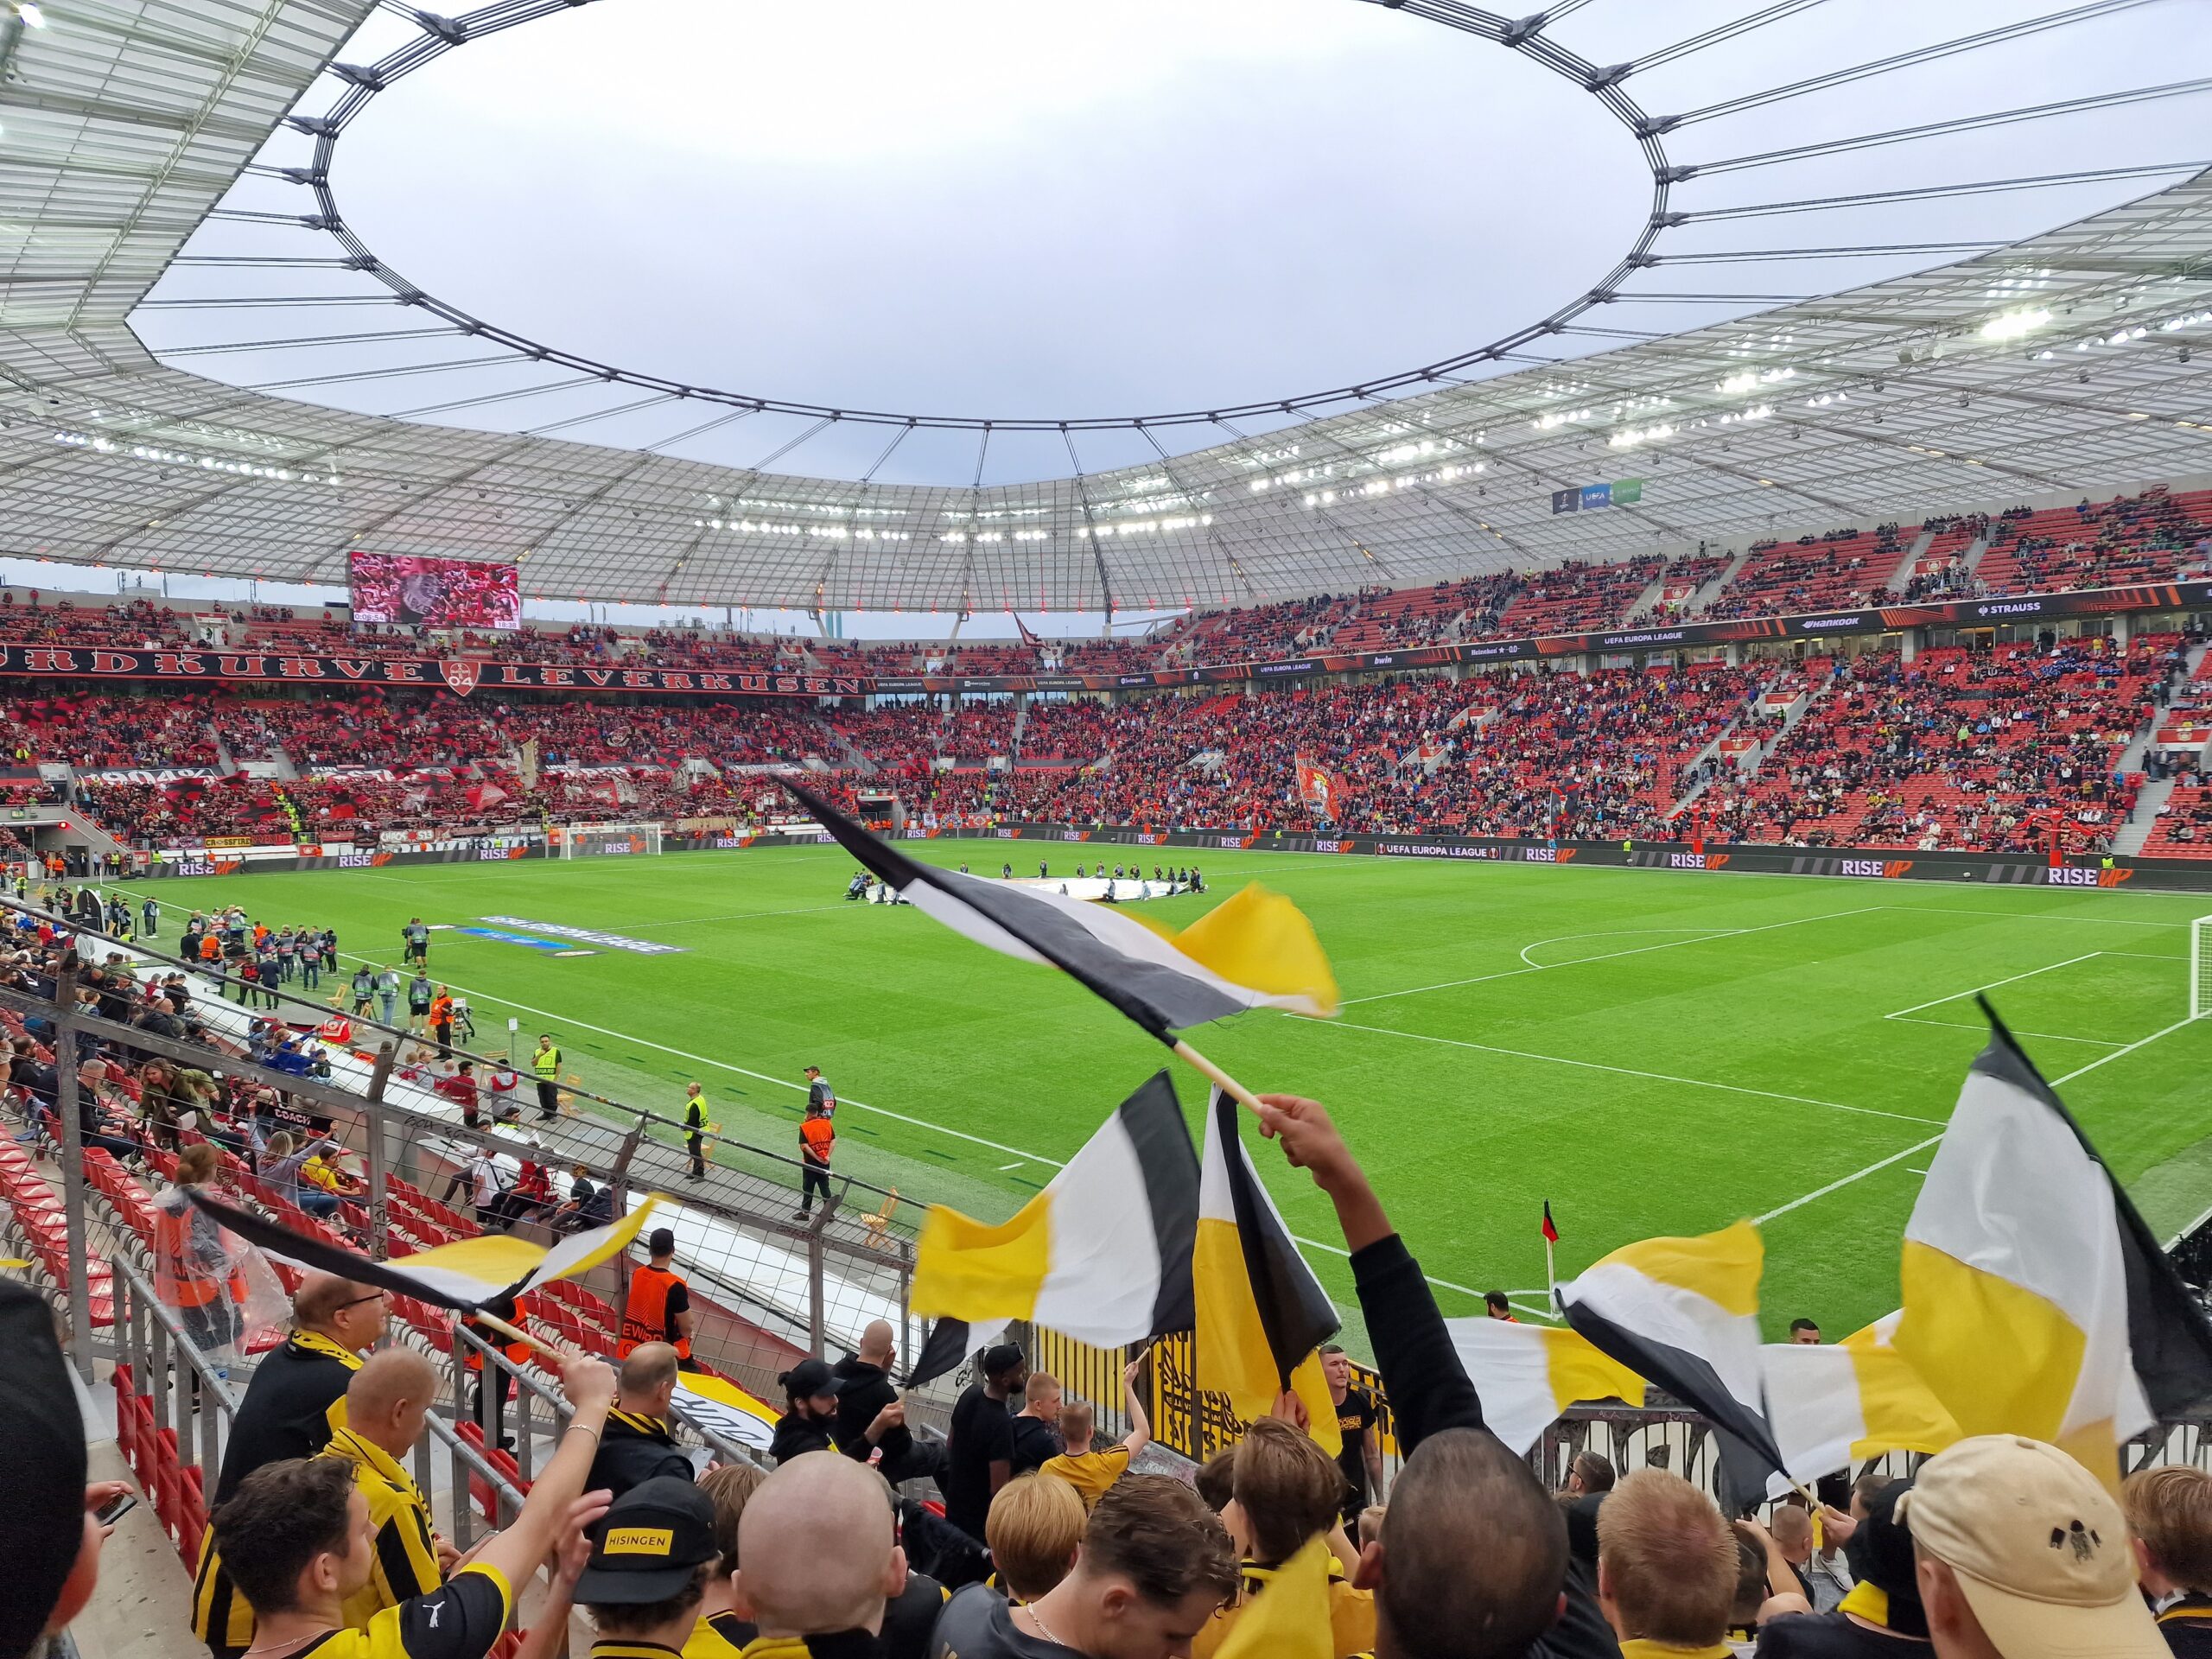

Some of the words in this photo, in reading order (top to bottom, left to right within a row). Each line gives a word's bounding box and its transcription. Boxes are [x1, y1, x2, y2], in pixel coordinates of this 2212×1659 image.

[1586, 492, 1605, 500] UEFA
[1990, 601, 2041, 614] STRAUSS
[1624, 634, 1653, 643] EUROPA
[1654, 632, 1683, 641] LEAGUE
[0, 648, 423, 681] RDKURVE
[1374, 655, 1392, 664] bwin
[448, 676, 474, 687] 04
[501, 666, 859, 694] LEVERKUSEN
[907, 829, 926, 838] RISE
[997, 829, 1012, 838] RISE
[1064, 830, 1080, 841] RISE
[1138, 834, 1155, 844] RISE
[605, 842, 631, 854] RISE
[717, 837, 740, 848] RISE
[1221, 836, 1241, 848] RISE
[1316, 841, 1339, 853] RISE
[480, 849, 509, 860] RISE
[1387, 845, 1410, 854] UEFA
[1412, 846, 1447, 855] EUROPA
[1449, 848, 1487, 857] LEAGUE
[1525, 849, 1555, 862] RISE
[1555, 849, 1577, 863] UP
[339, 855, 372, 868] RISE
[372, 851, 394, 867] UP
[1670, 854, 1705, 868] RISE
[1705, 854, 1730, 870] UP
[178, 861, 215, 876] RISE
[1841, 860, 1884, 876] RISE
[1884, 861, 1914, 878] UP
[2048, 868, 2098, 885] RISE
[2098, 868, 2133, 887] UP
[608, 1535, 665, 1546] HISINGEN
